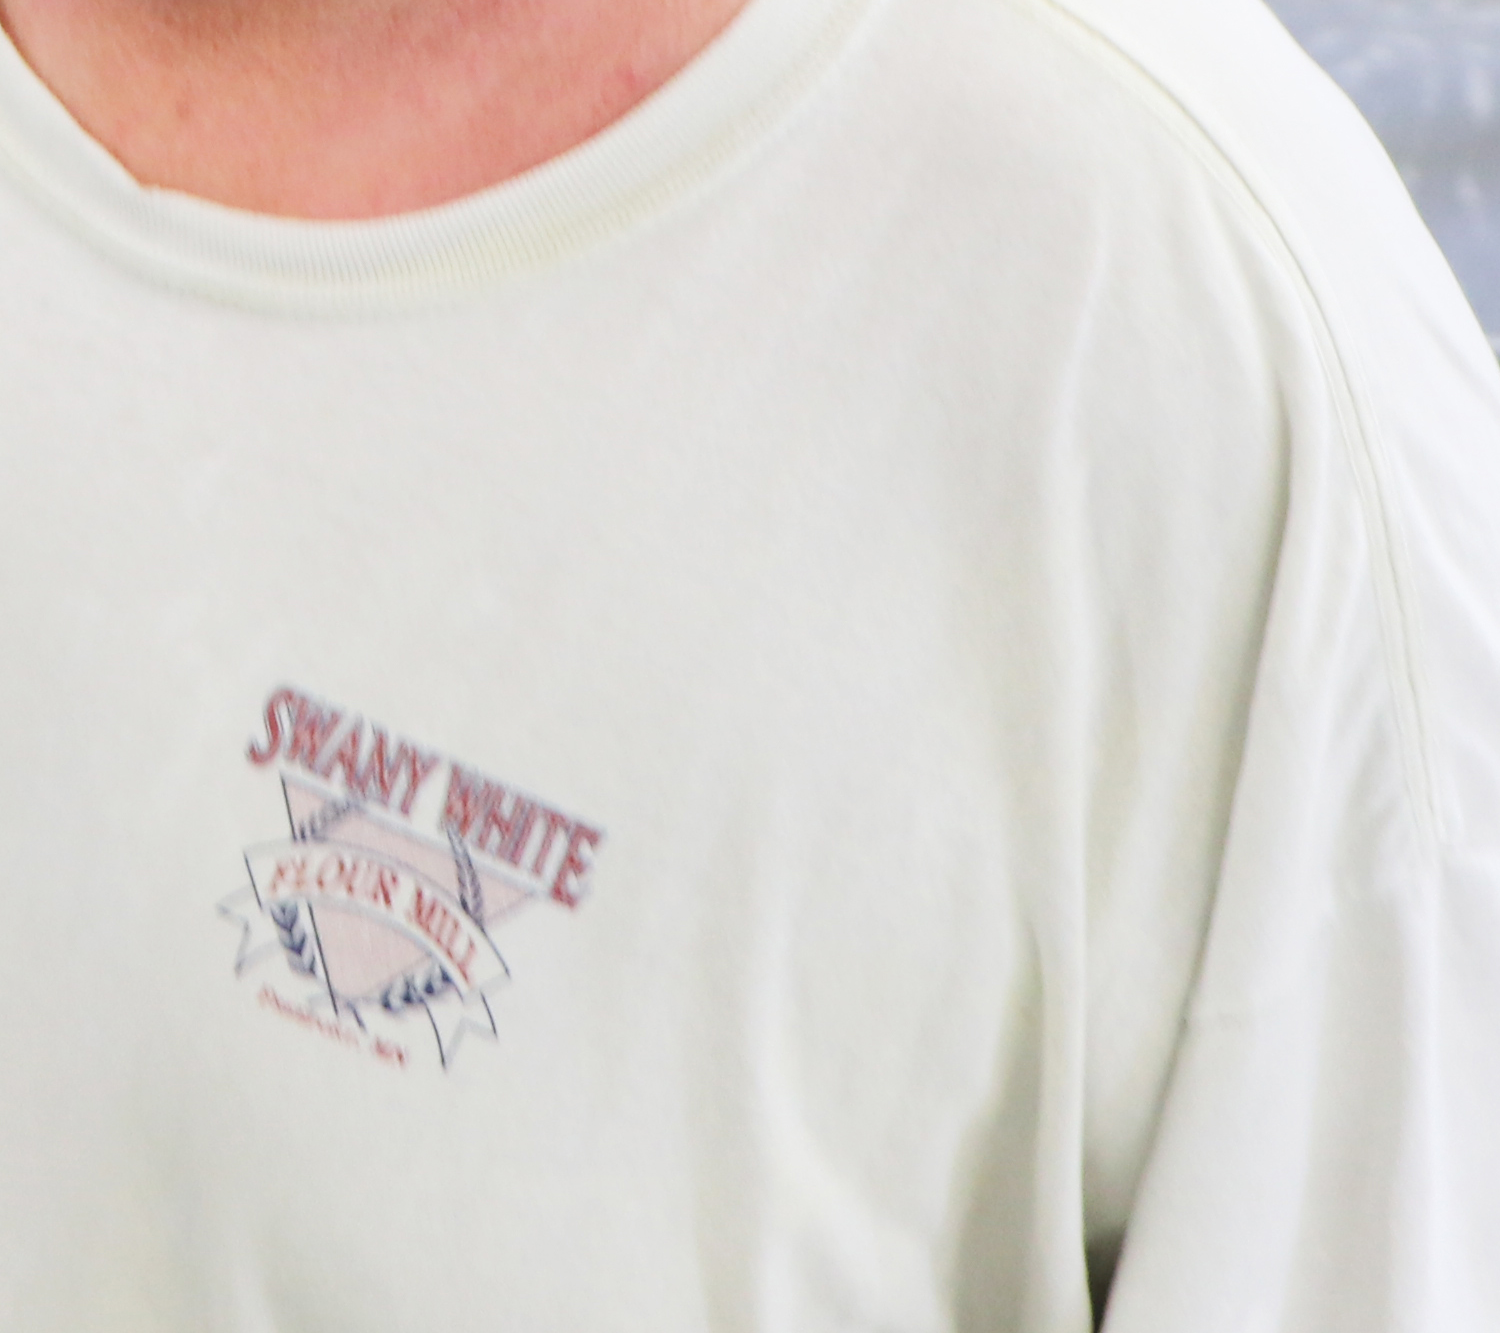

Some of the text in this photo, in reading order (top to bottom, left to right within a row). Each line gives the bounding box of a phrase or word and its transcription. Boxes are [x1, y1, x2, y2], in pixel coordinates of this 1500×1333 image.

[246, 686, 606, 911] SWANY WHITE
[268, 853, 478, 993] FLOUR MILL
